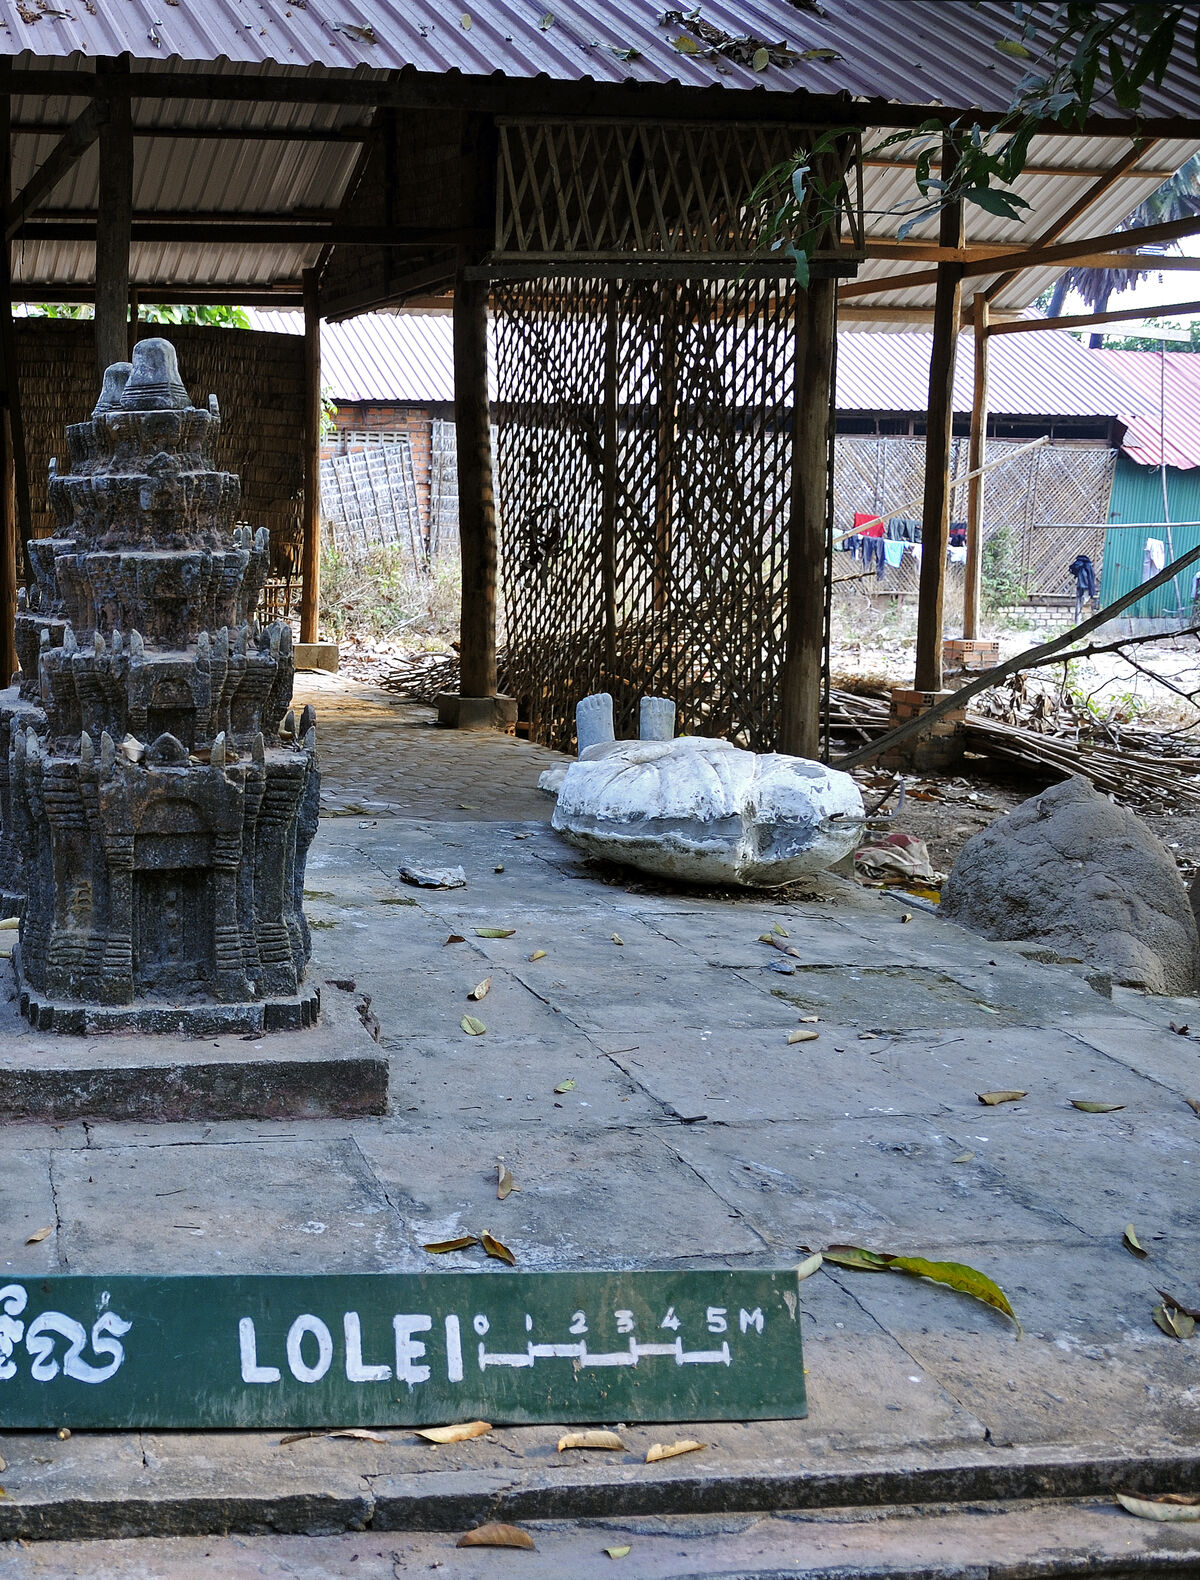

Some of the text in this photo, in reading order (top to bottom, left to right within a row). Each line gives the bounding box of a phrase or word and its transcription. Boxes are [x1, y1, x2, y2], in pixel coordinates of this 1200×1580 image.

[568, 1310, 589, 1334] 2
[614, 1309, 636, 1334] 3
[660, 1306, 682, 1331] 4
[238, 1311, 464, 1391] LOLEI
